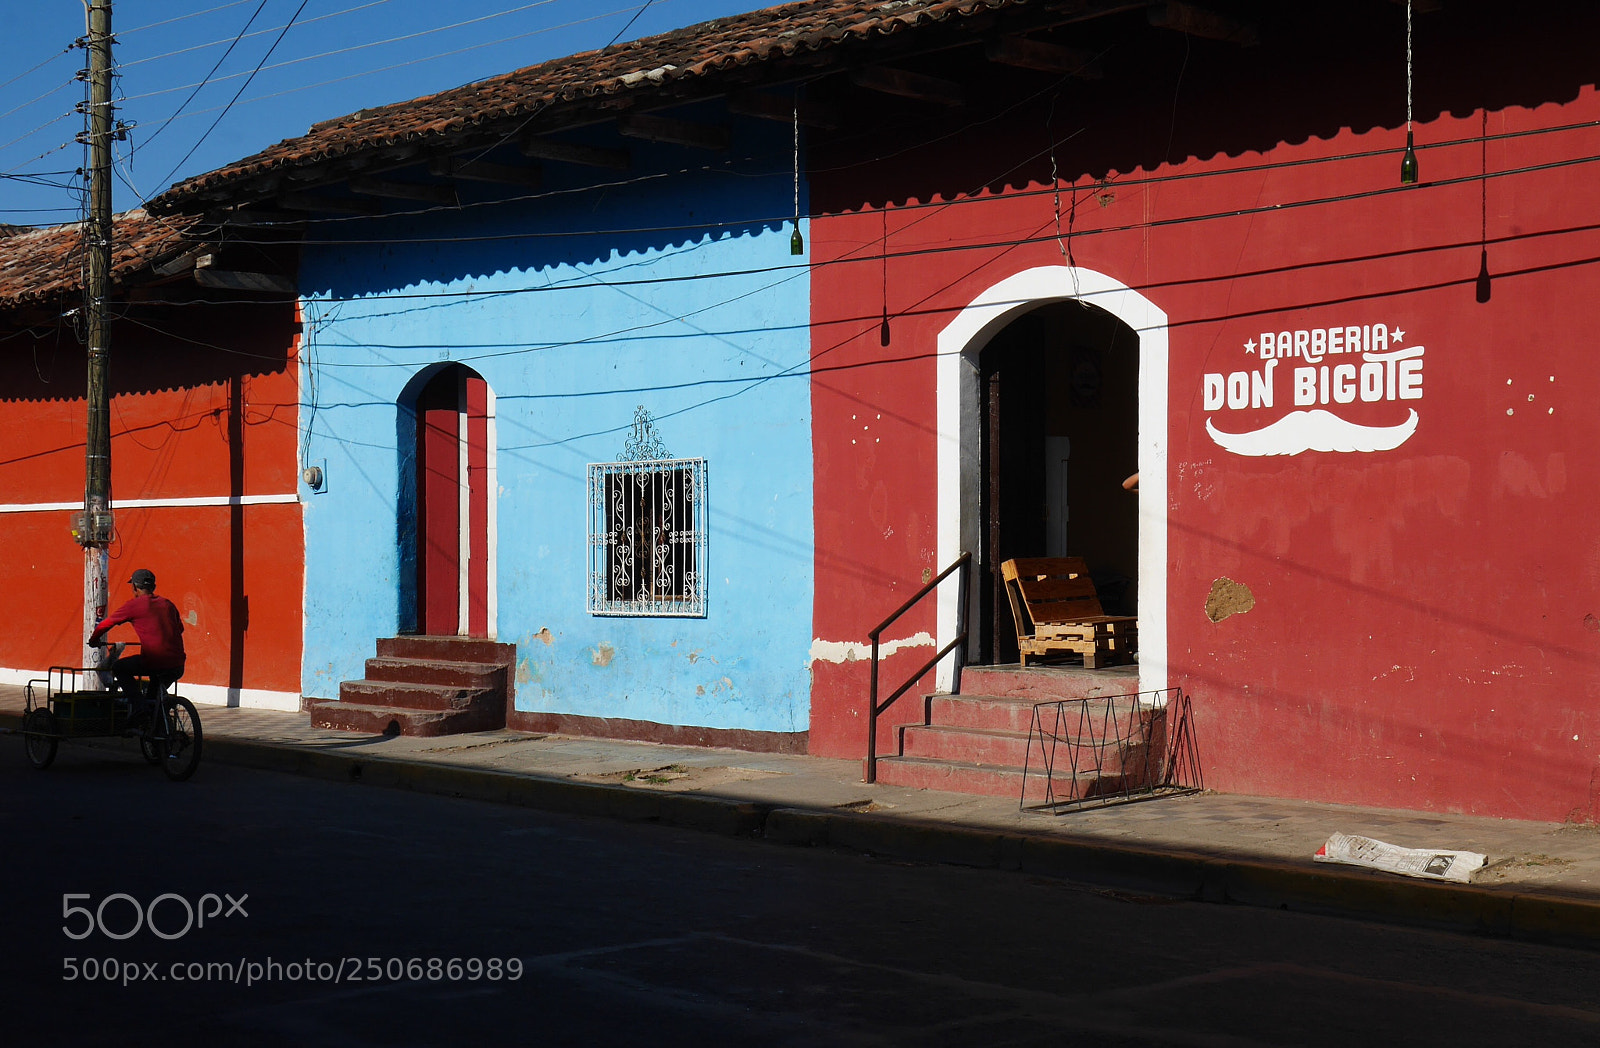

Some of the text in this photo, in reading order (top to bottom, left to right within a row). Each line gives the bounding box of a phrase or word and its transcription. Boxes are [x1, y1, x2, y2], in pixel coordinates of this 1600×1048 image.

[1259, 323, 1388, 364] BARBERIA
[1203, 345, 1425, 411] DON BIGOTE
